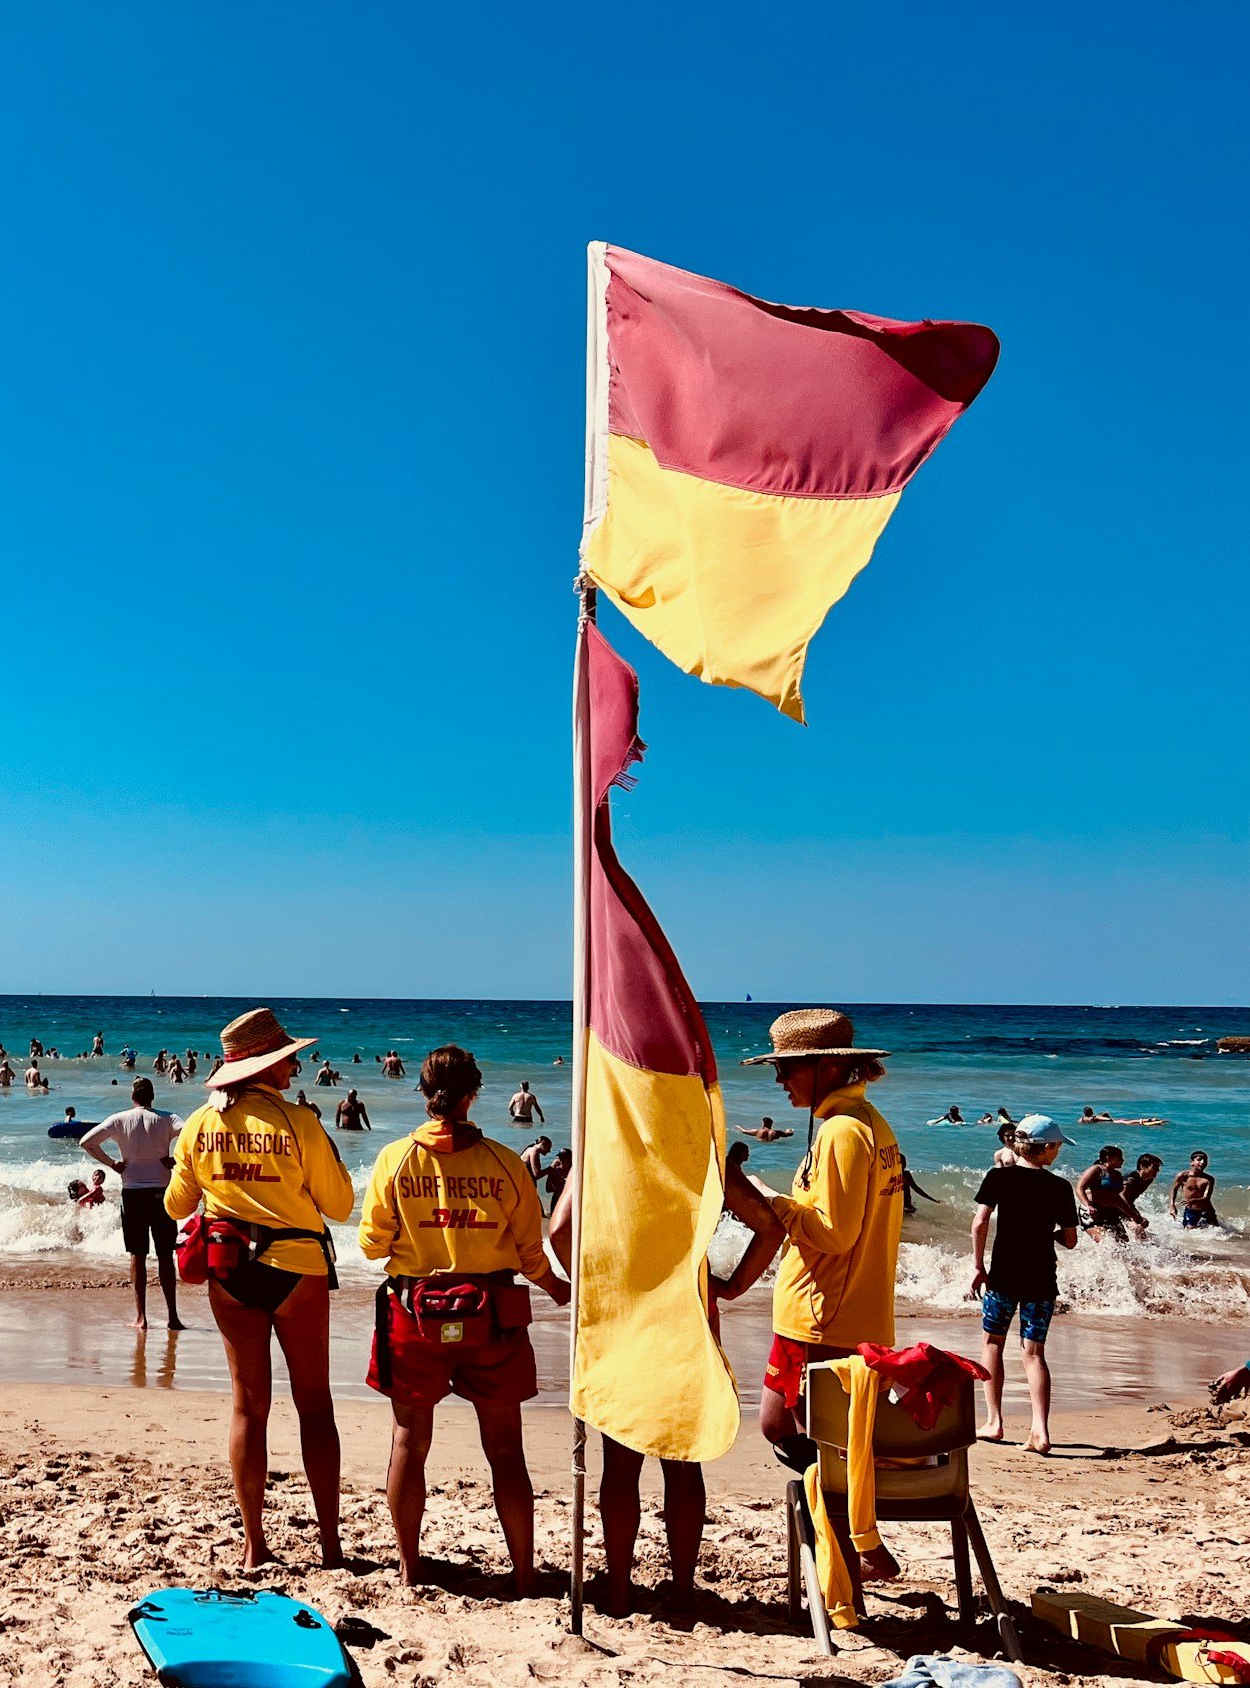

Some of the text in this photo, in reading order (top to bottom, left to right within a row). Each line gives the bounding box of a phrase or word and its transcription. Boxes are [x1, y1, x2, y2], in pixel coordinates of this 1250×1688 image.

[197, 1131, 291, 1156] SURF RESCUE
[222, 1162, 281, 1182] DHL
[400, 1175, 504, 1201] SURF RESCUE
[432, 1208, 498, 1229] DHL
